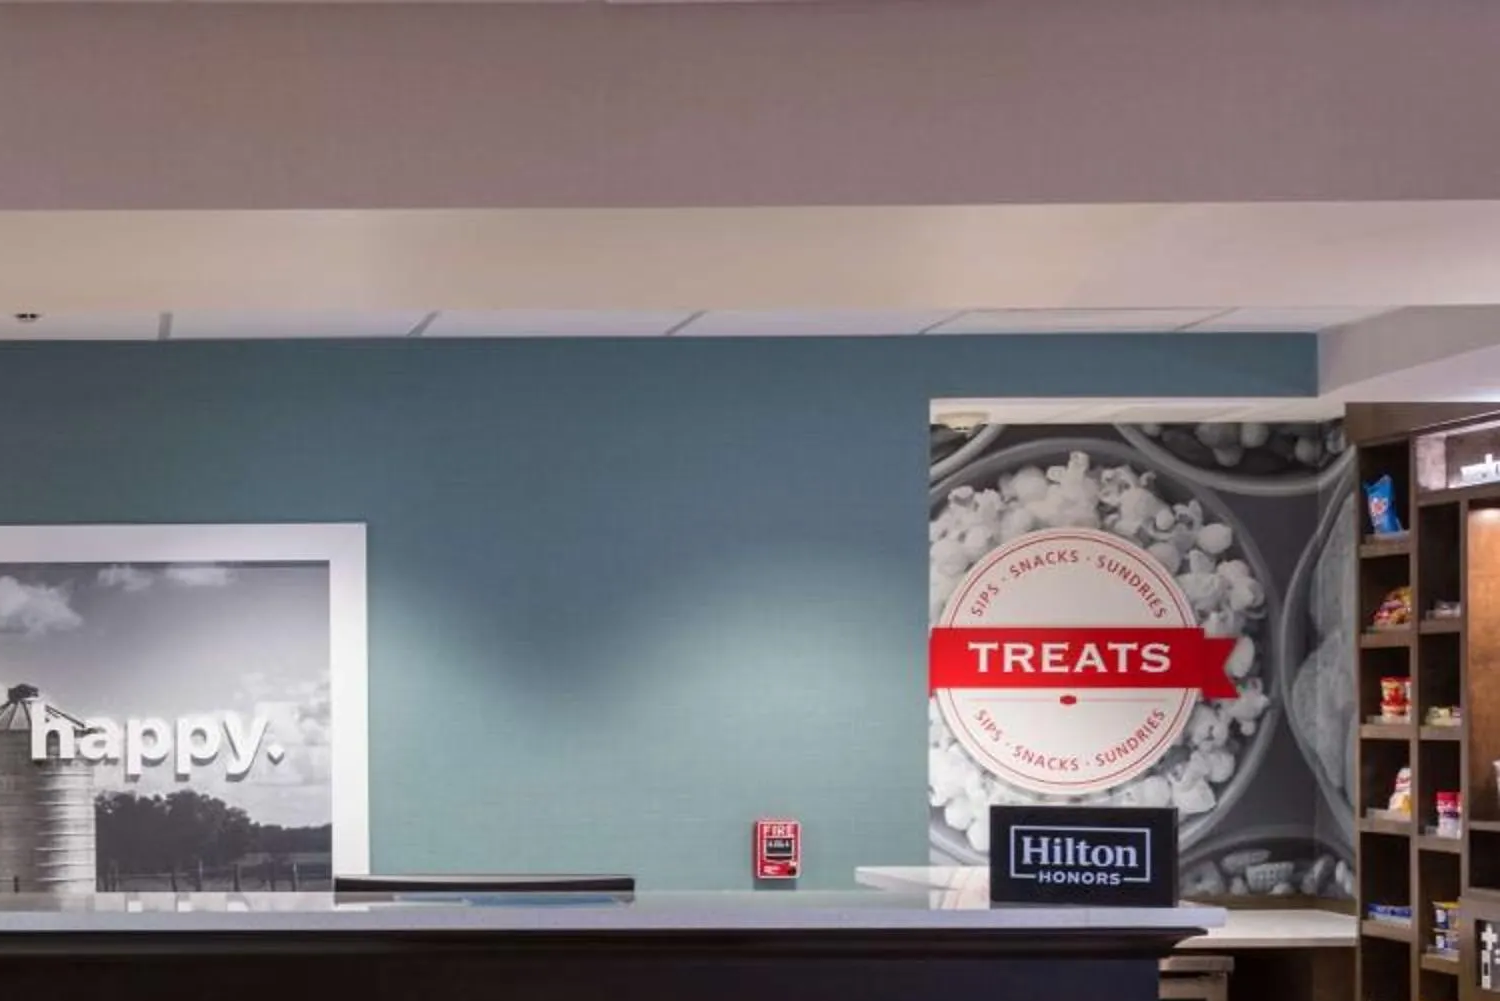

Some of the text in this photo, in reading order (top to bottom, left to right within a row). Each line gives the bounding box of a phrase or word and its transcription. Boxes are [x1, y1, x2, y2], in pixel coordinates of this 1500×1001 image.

[970, 549, 1168, 619] SIPS SNACKS SUNDRIES
[967, 641, 1172, 674] TREATS
[30, 698, 285, 778] happy.
[975, 707, 1166, 772] SIPS SNACKS SUNDRIES
[1021, 835, 1140, 868] Hilton
[1038, 869, 1122, 886] HONORS
